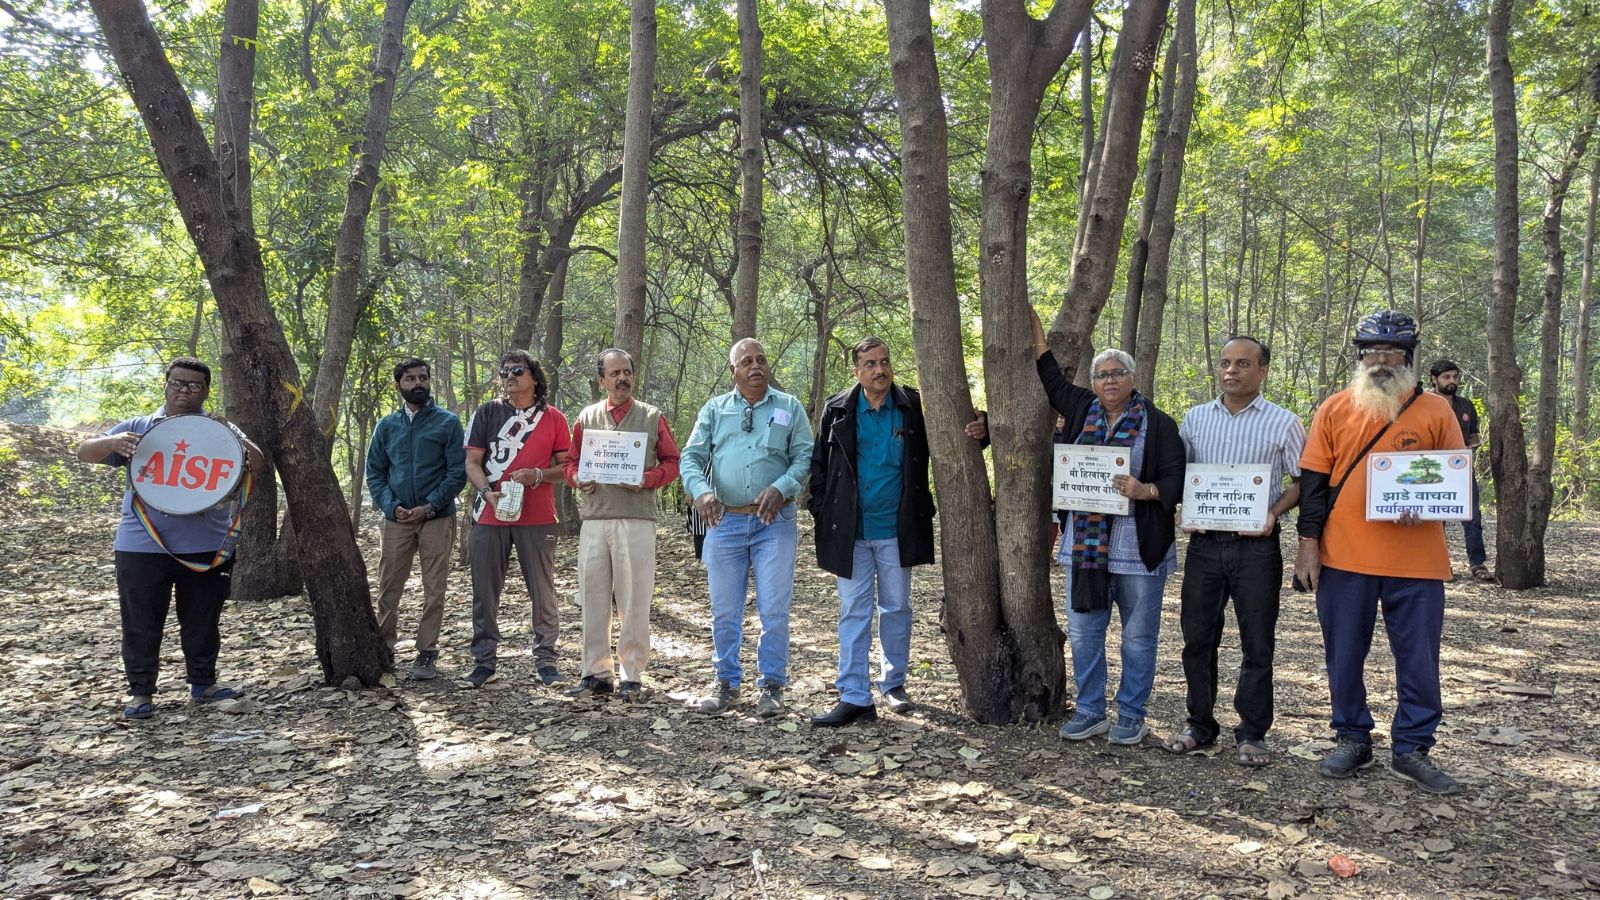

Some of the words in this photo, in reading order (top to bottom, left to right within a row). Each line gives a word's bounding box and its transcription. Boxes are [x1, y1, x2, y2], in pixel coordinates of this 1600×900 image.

[136, 450, 234, 490] AISF
[1069, 468, 1078, 478] मी
[1060, 481, 1069, 491] मी
[1071, 482, 1101, 494] पर्यावरण
[1195, 489, 1220, 501] क्लीन
[1223, 489, 1256, 501] नाशिक
[1382, 489, 1410, 502] झाडे
[1414, 491, 1457, 501] वाचवा
[1197, 503, 1216, 515] ग्रीन
[1218, 503, 1252, 515] नाशिक
[1376, 502, 1424, 514] पर्यावरण
[1427, 505, 1464, 514] वाचवा
